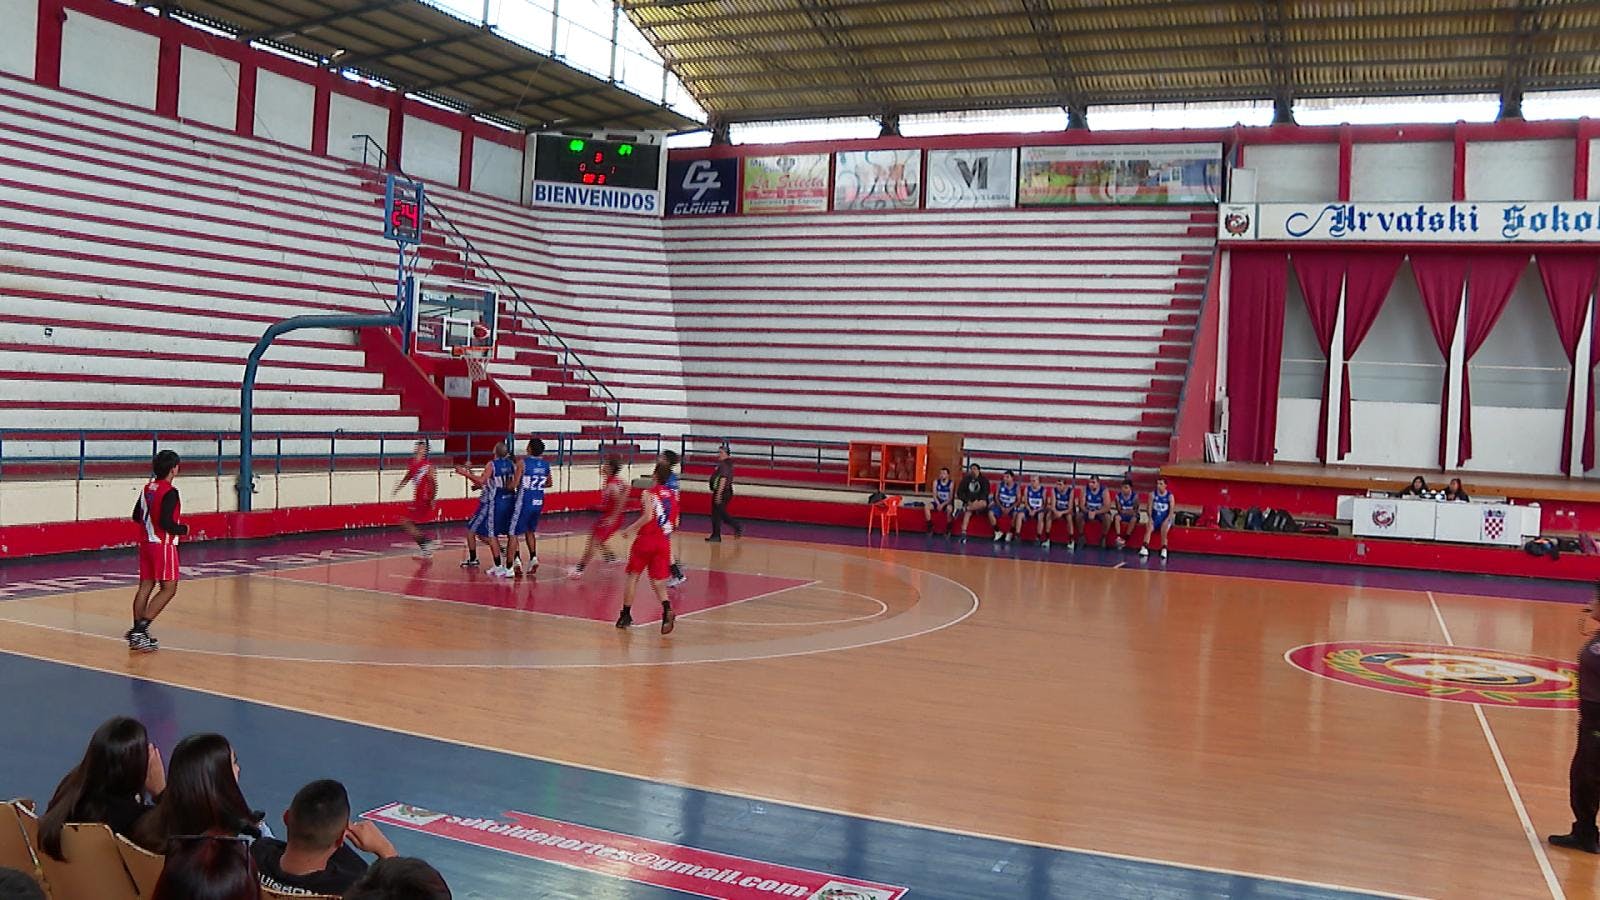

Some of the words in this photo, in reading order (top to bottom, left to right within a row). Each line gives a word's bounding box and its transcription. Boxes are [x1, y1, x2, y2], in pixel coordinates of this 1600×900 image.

[535, 184, 655, 210] BIENVENIDOS
[392, 199, 417, 228] 24
[1286, 204, 1479, 238] Hrvatski
[1502, 204, 1600, 239] Soko
[530, 475, 547, 490] 22
